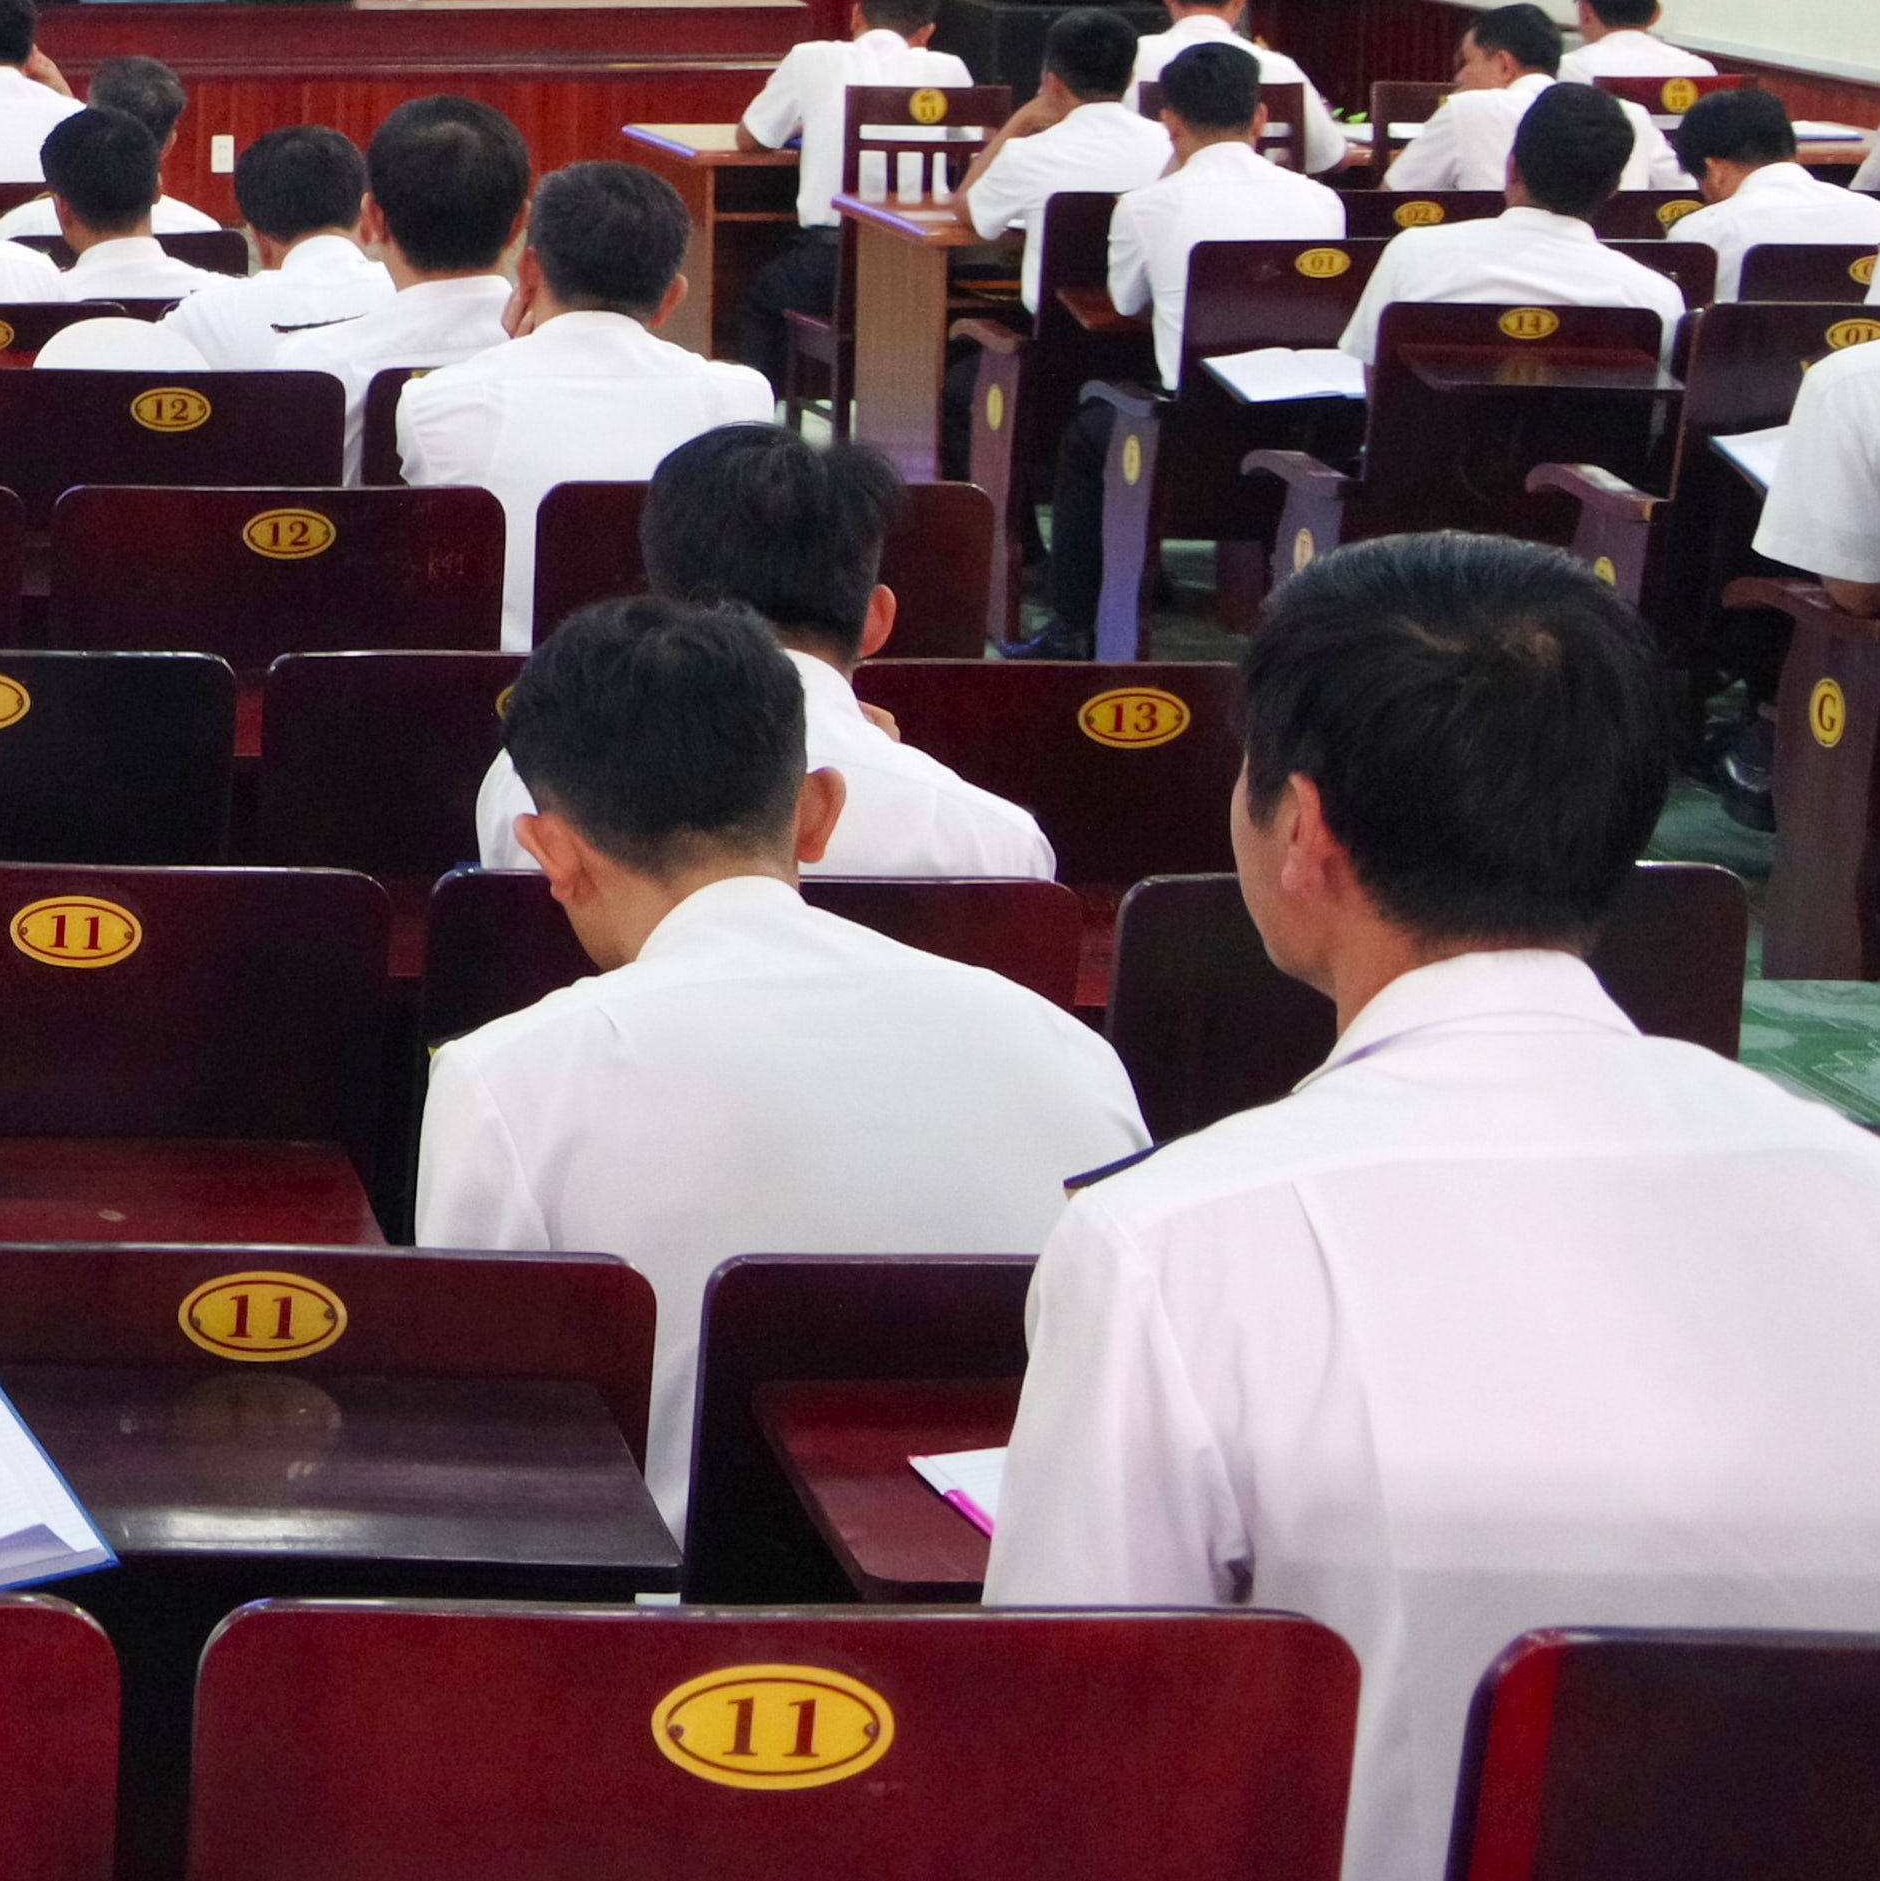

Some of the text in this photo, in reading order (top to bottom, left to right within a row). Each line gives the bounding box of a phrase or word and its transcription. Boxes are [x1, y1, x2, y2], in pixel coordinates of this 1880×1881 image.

[156, 398, 188, 421] 12
[268, 521, 309, 546] 12
[1108, 701, 1158, 734] 13
[1818, 693, 1836, 731] G
[49, 914, 102, 952] 11
[227, 1295, 297, 1341] 11
[727, 1696, 822, 1760] 11
